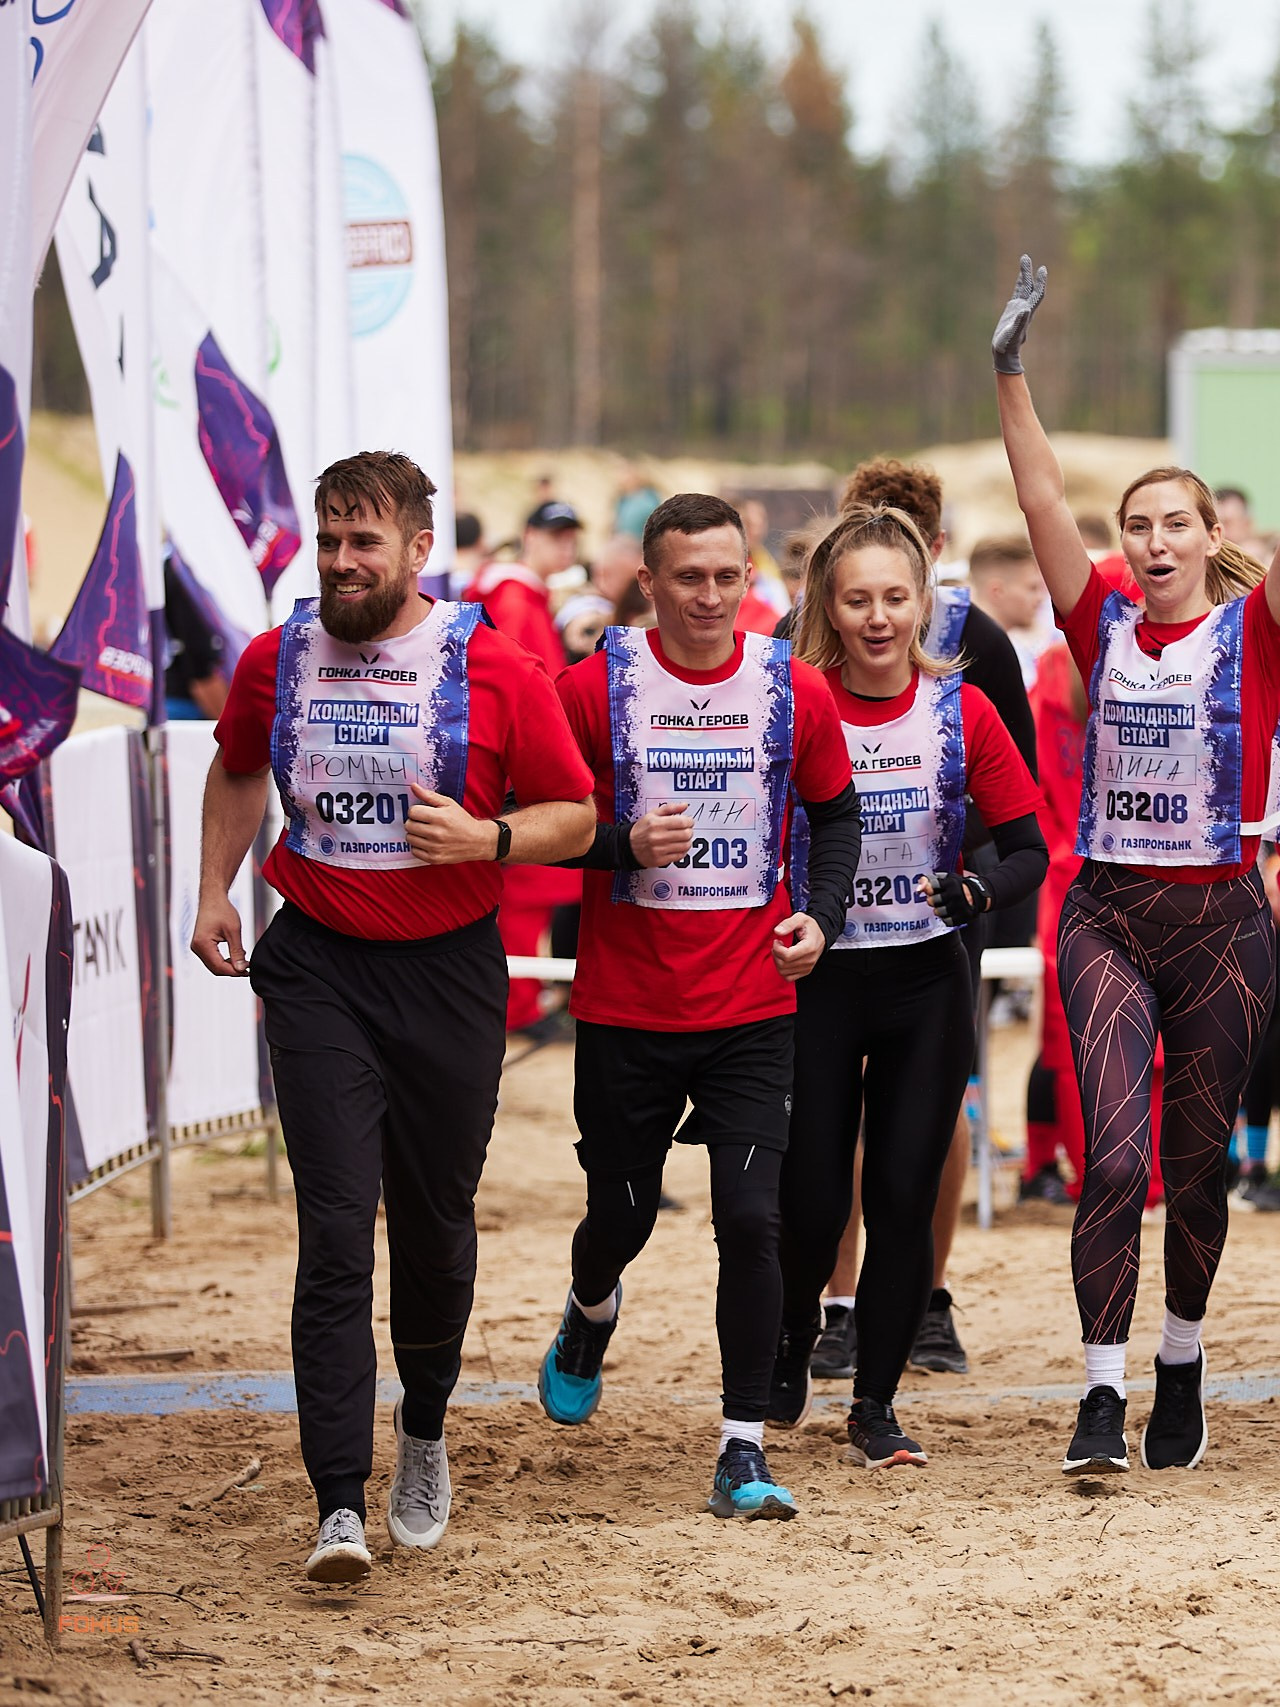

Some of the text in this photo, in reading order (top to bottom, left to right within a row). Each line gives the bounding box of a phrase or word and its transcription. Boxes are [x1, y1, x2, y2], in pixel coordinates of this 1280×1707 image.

[318, 667, 417, 682] ГОНКА ГЕРОЕВ
[1109, 668, 1192, 690] ГОНКА ГЕРОЕВ
[310, 702, 418, 724] КОМАНДНЫЙ
[649, 714, 749, 727] ГОНКА ГЕРОЕВ
[1105, 703, 1194, 728] КОМАНДНЫЙ
[338, 724, 387, 743] СТАРТ
[1121, 727, 1166, 746] СТАРТ
[309, 753, 406, 784] РОМАН
[649, 748, 752, 770] КОМАНДНЫЙ
[872, 755, 921, 769] ГЕРОЕВ
[1107, 754, 1184, 782] АЛИНА
[676, 773, 724, 790] СТАРТ
[316, 791, 410, 825] 03201
[1107, 790, 1188, 824] 03208
[340, 842, 413, 854] ГАЗПРОМБАН
[658, 837, 748, 869] 203
[1121, 838, 1192, 851] ГАЗПРОМБАНК
[677, 885, 749, 897] ГАЗПРОМБАНК
[864, 918, 930, 932] ГАЗПРОМБАНК
